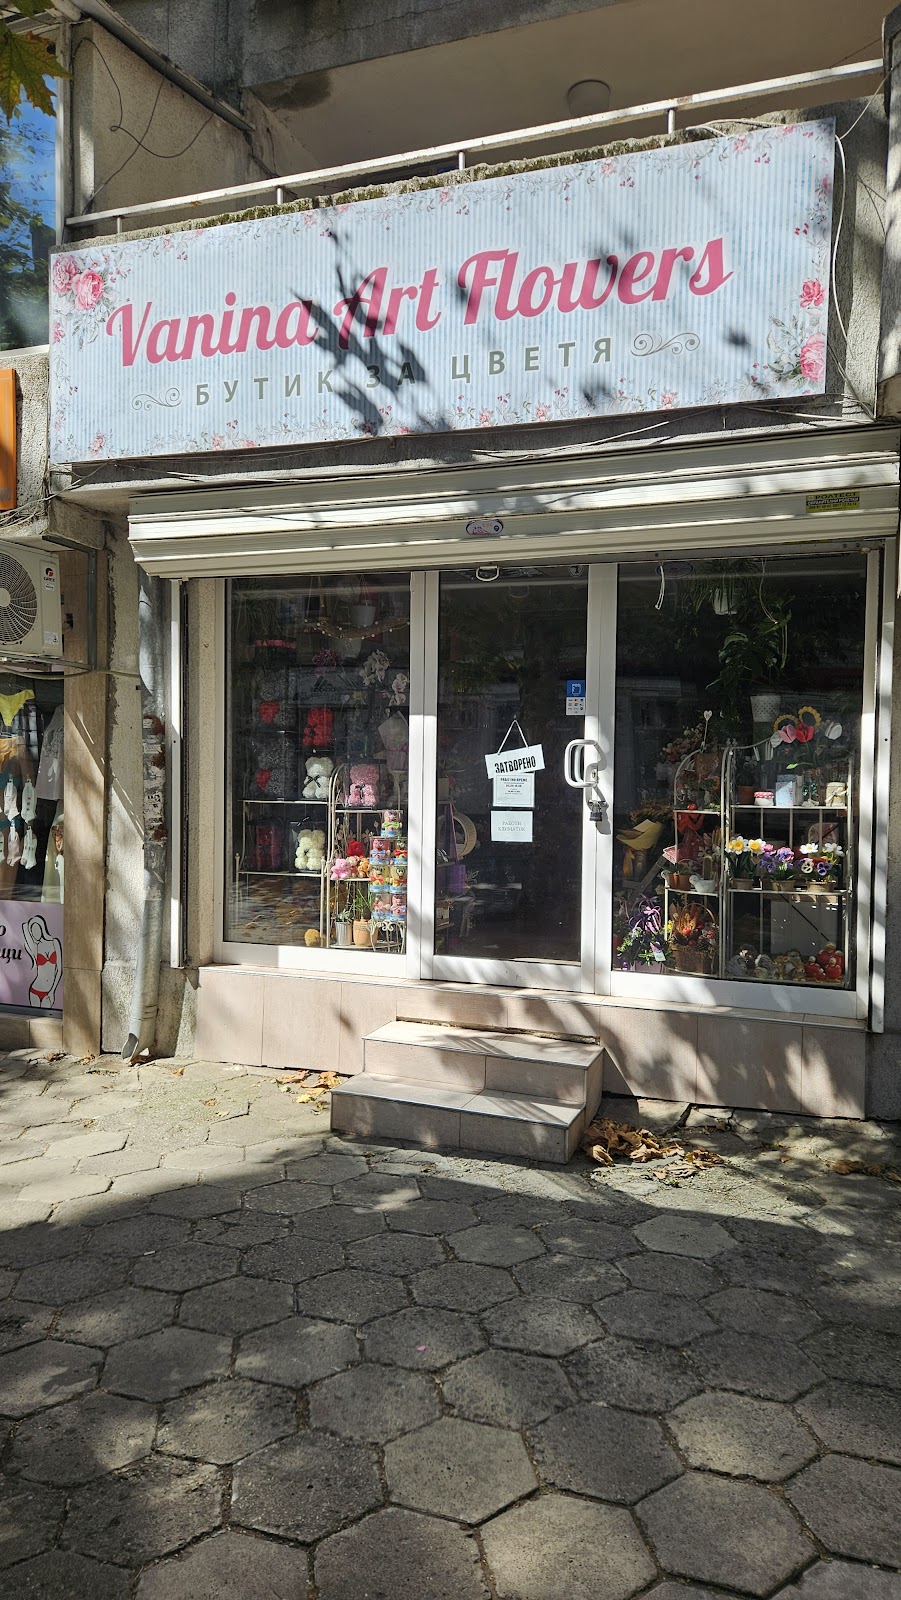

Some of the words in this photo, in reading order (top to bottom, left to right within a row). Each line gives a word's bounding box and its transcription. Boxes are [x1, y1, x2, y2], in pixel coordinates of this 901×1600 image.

[106, 291, 319, 367] Vanina
[333, 266, 442, 350] Art
[457, 237, 734, 325] Flowers
[195, 368, 334, 406] БУТИК
[366, 361, 415, 389] ЗА
[451, 337, 612, 384] ЦВЕТЯ
[494, 756, 536, 773] ЗАТВОРЕНО
